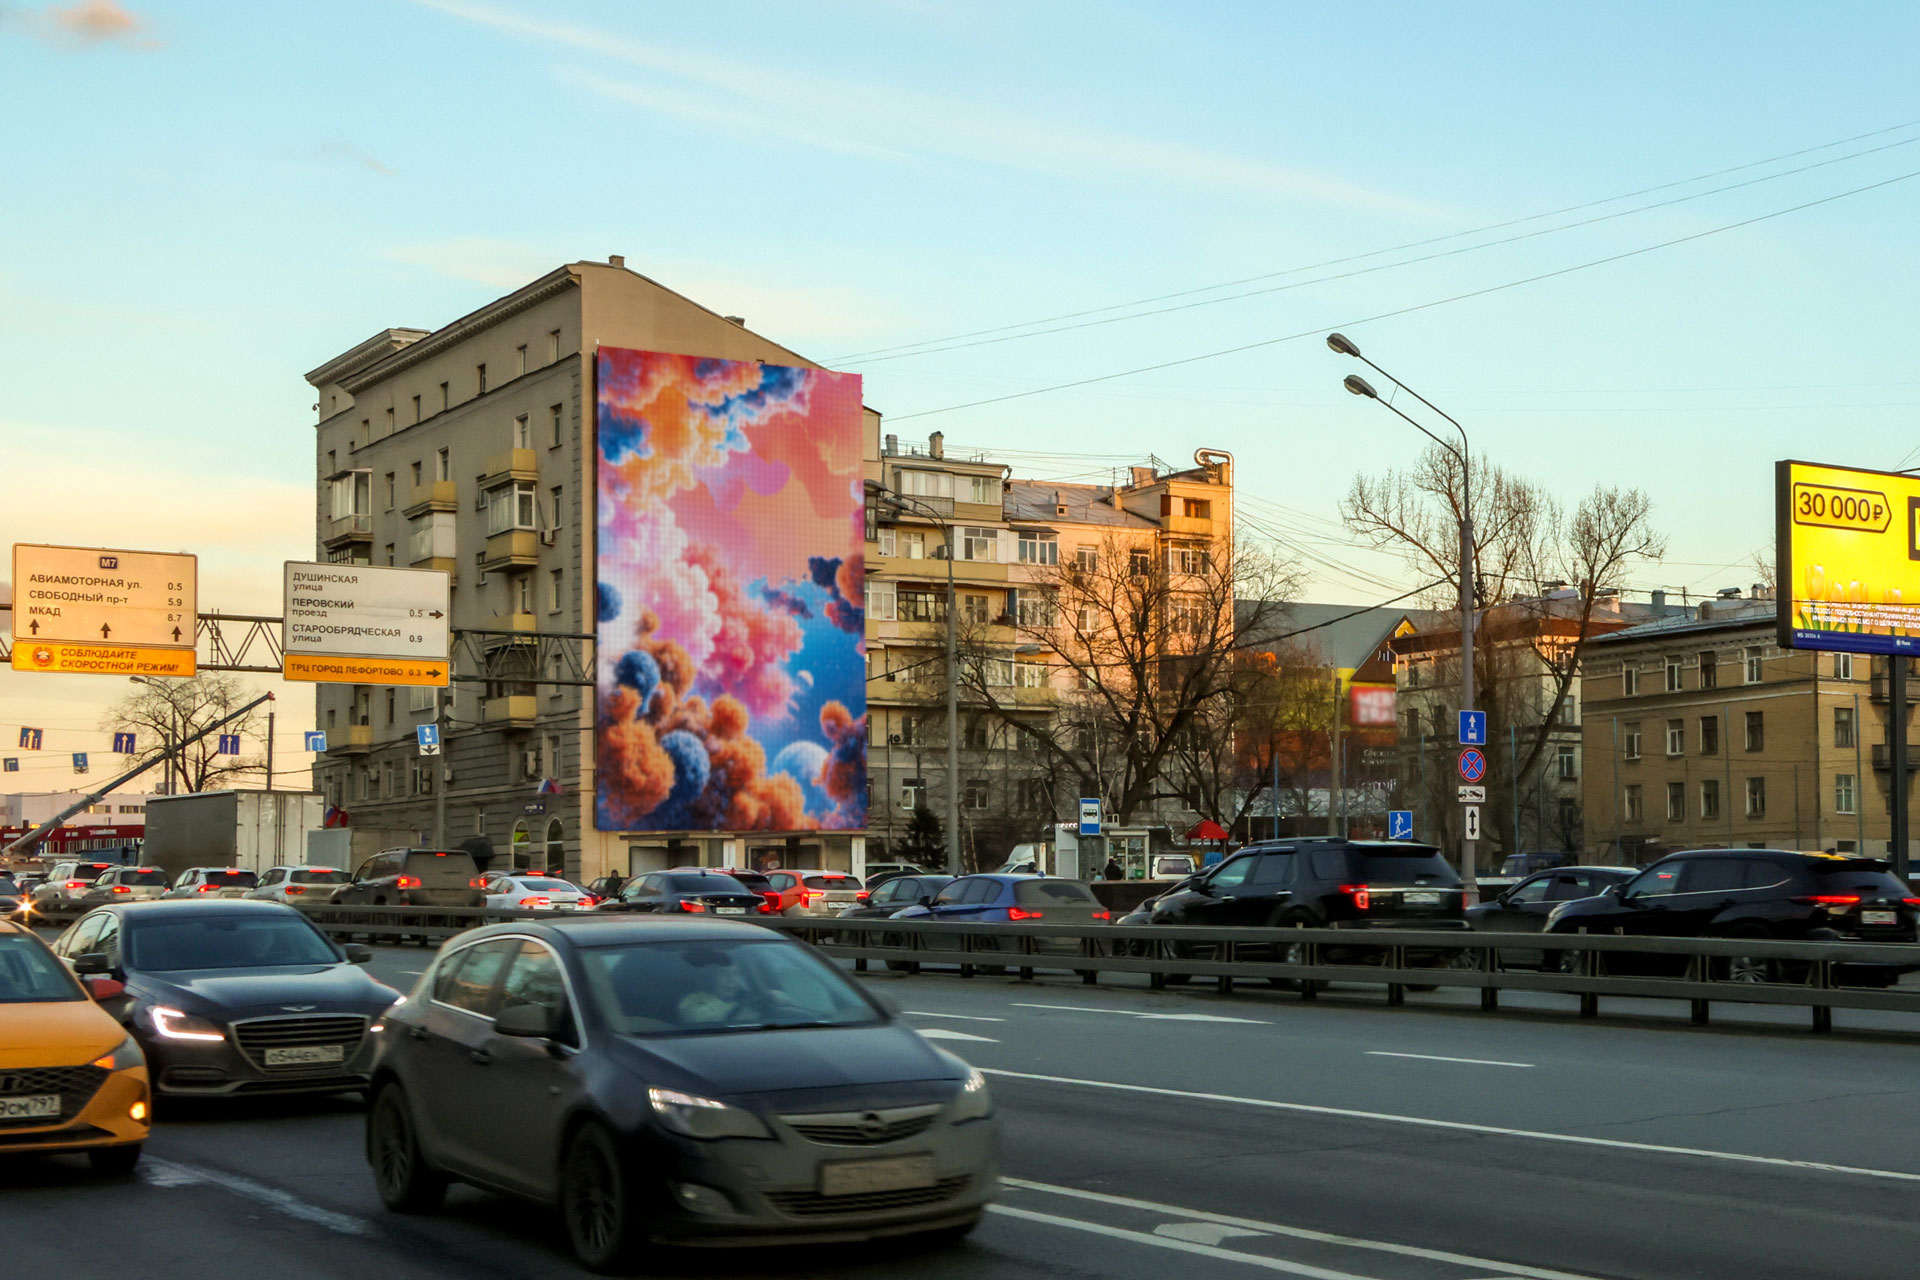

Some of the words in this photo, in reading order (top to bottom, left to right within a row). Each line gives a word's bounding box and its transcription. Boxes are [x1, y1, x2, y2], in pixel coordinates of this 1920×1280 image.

[1800, 492, 1825, 517] 30
[29, 573, 124, 588] АВИАМОТОРНАЯ
[126, 580, 143, 590] ул.
[167, 582, 183, 591] 0.5
[293, 572, 359, 584] ДУШИНСКАЯ
[293, 583, 323, 592] улица
[29, 589, 104, 603] СВОБОДНЫЙ
[106, 595, 129, 605] пр-т
[167, 598, 183, 607] 5.9
[292, 598, 355, 609] ПЕРОВСКИЙ
[28, 606, 62, 617] МКАД
[167, 613, 182, 622] 8.7
[292, 609, 328, 618] проезд
[409, 609, 423, 618] 0.5
[292, 623, 401, 637] СТАРООБРЯДЧЕСКАЯ
[292, 634, 322, 643] улица
[409, 635, 423, 643] 0.9
[136, 662, 180, 673] РЕЖИМ!
[291, 663, 310, 672] ТРЦ
[312, 664, 344, 674] ГОРОД
[346, 665, 404, 676] ЛЕФОРТОВО
